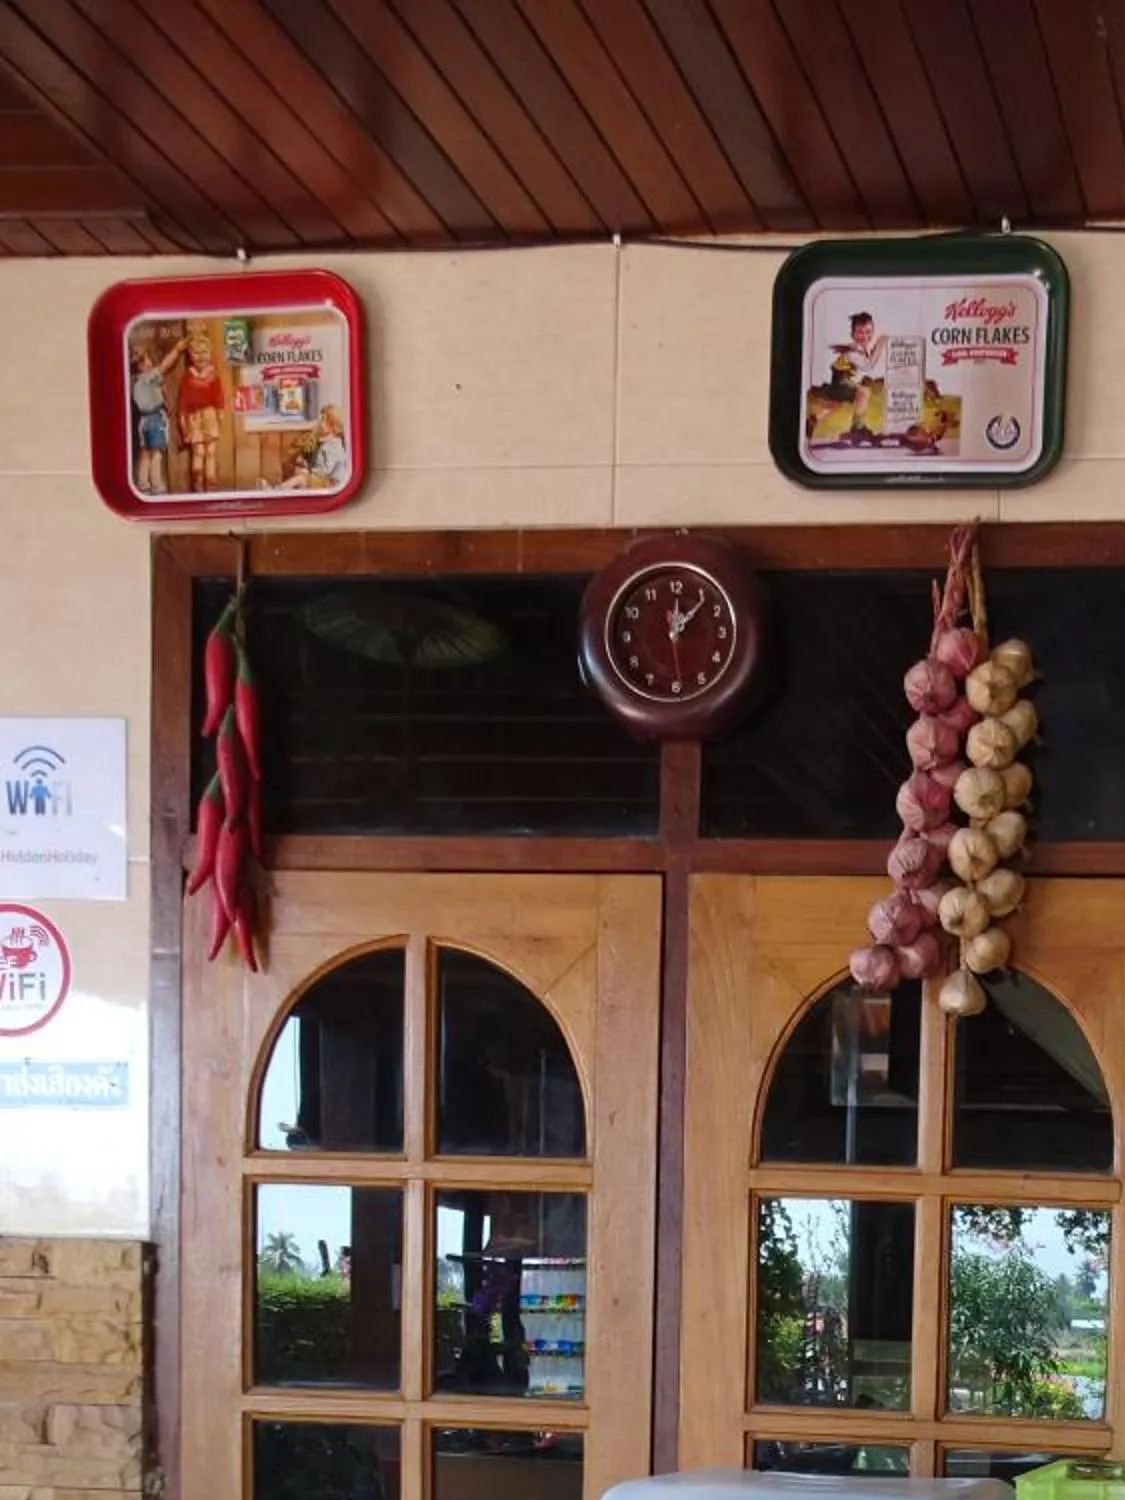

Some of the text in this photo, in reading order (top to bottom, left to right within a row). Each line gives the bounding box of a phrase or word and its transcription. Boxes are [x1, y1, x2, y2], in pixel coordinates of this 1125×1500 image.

[944, 298, 1016, 325] Kellogg's
[931, 326, 1030, 345] CORN FLAKES
[669, 580, 683, 594] 12
[645, 588, 657, 601] 11
[625, 606, 639, 619] 10
[713, 604, 721, 617] 2
[623, 631, 631, 643] 9
[718, 627, 727, 639] 3
[711, 651, 721, 663] 4
[645, 673, 655, 686] 7
[697, 672, 707, 685] 5
[671, 681, 681, 693] 6
